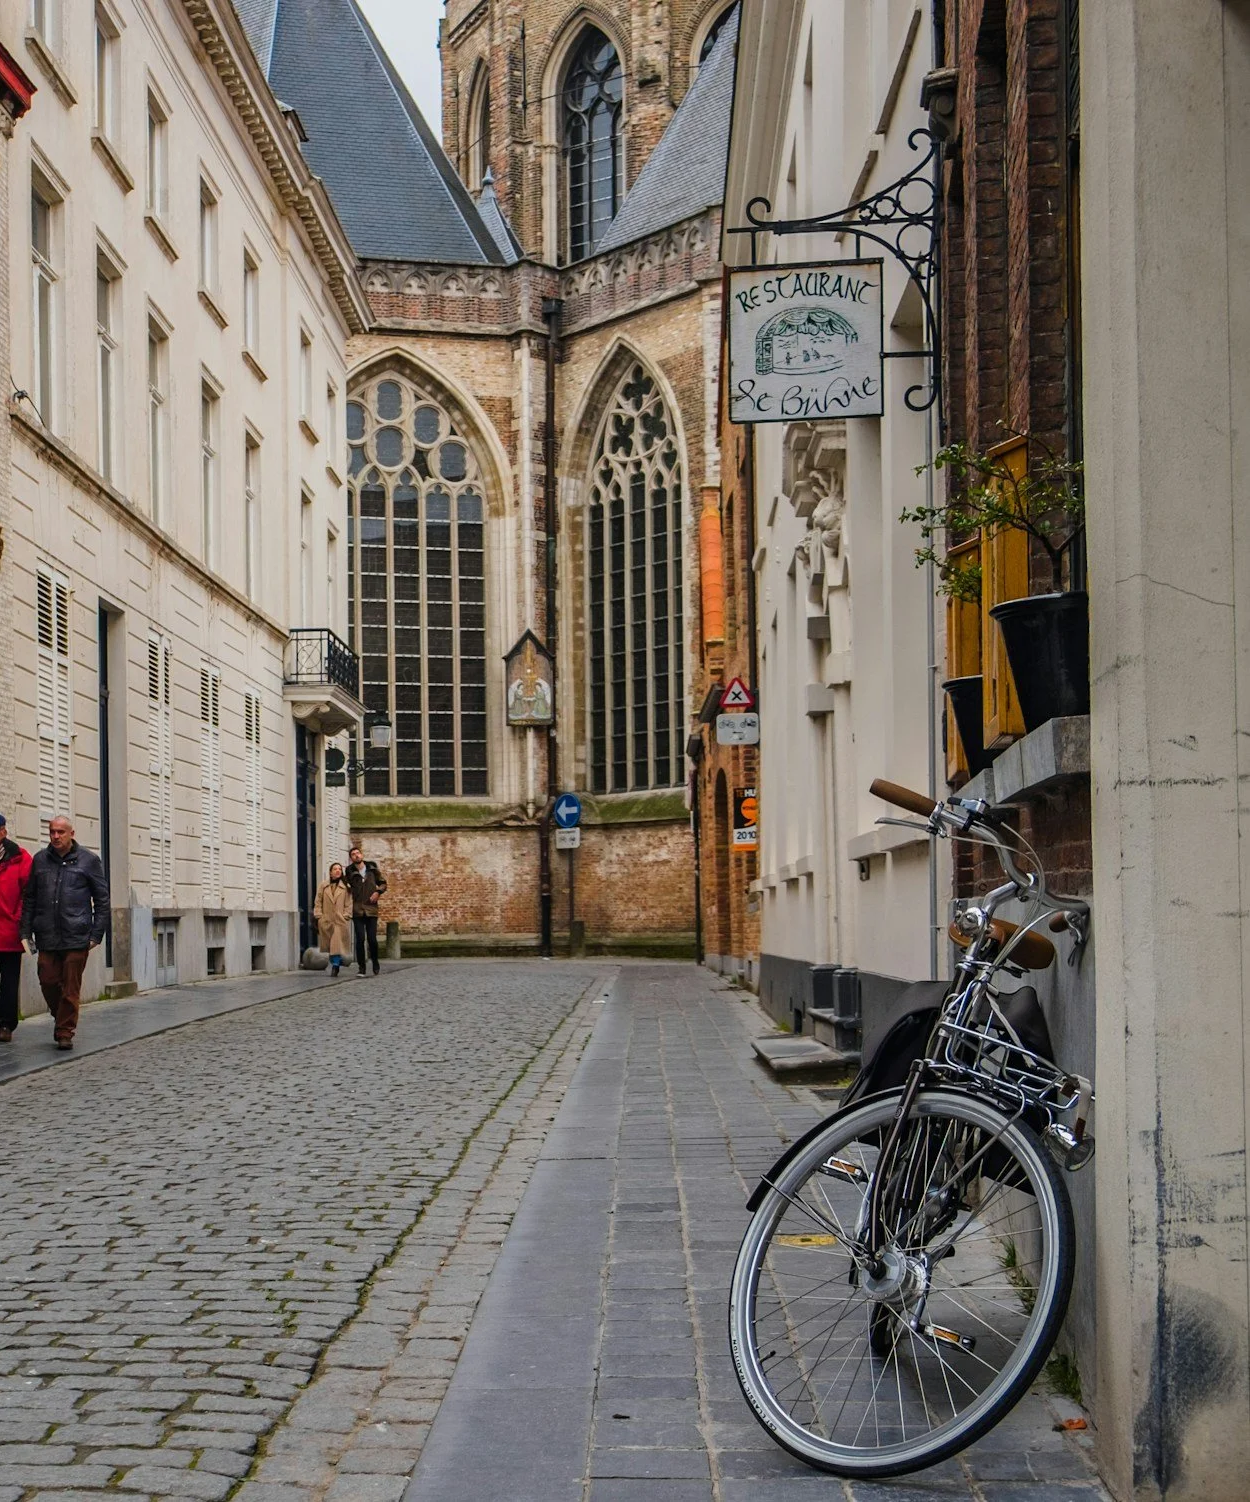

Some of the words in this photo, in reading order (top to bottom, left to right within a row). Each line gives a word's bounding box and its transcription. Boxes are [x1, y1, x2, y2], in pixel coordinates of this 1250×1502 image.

[736, 272, 878, 313] RESTAURANT
[733, 1339, 747, 1385] TRADITION
[746, 1386, 767, 1419] CLASSIC
